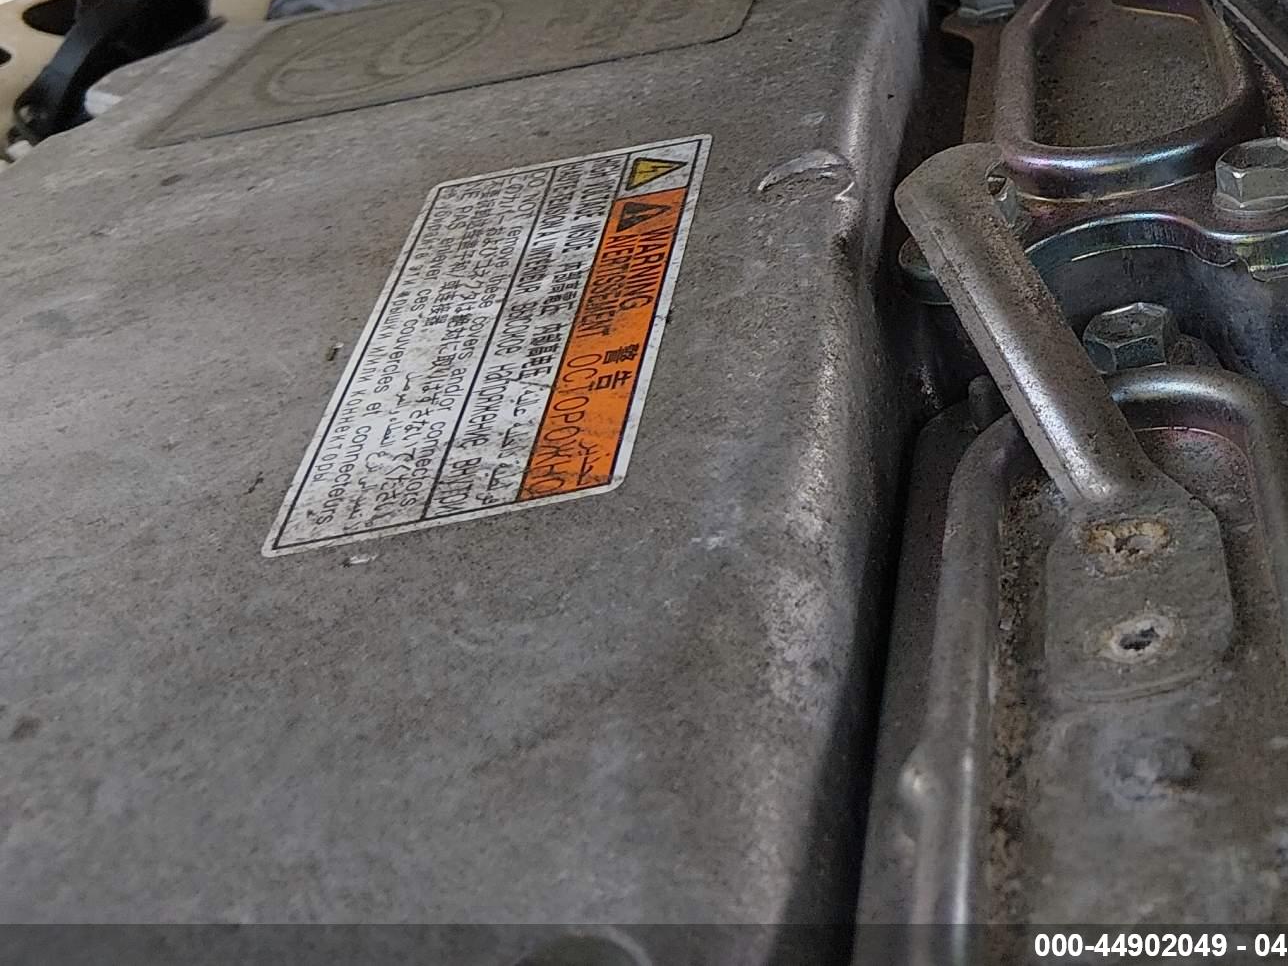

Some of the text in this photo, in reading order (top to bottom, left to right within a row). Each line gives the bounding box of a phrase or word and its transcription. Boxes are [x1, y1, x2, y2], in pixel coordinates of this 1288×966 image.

[444, 204, 475, 232] PAS
[492, 224, 525, 270] remove
[616, 224, 674, 313] WARNING
[408, 287, 434, 313] ces
[475, 272, 511, 310] these
[572, 230, 641, 342] AVERTISSEMENT
[371, 316, 425, 395] couvercles
[454, 314, 490, 361] covers
[433, 365, 473, 414] and/or
[592, 342, 641, 393] 警告
[451, 361, 517, 450] напряжение
[523, 350, 604, 497] ОСТОРОЖНО
